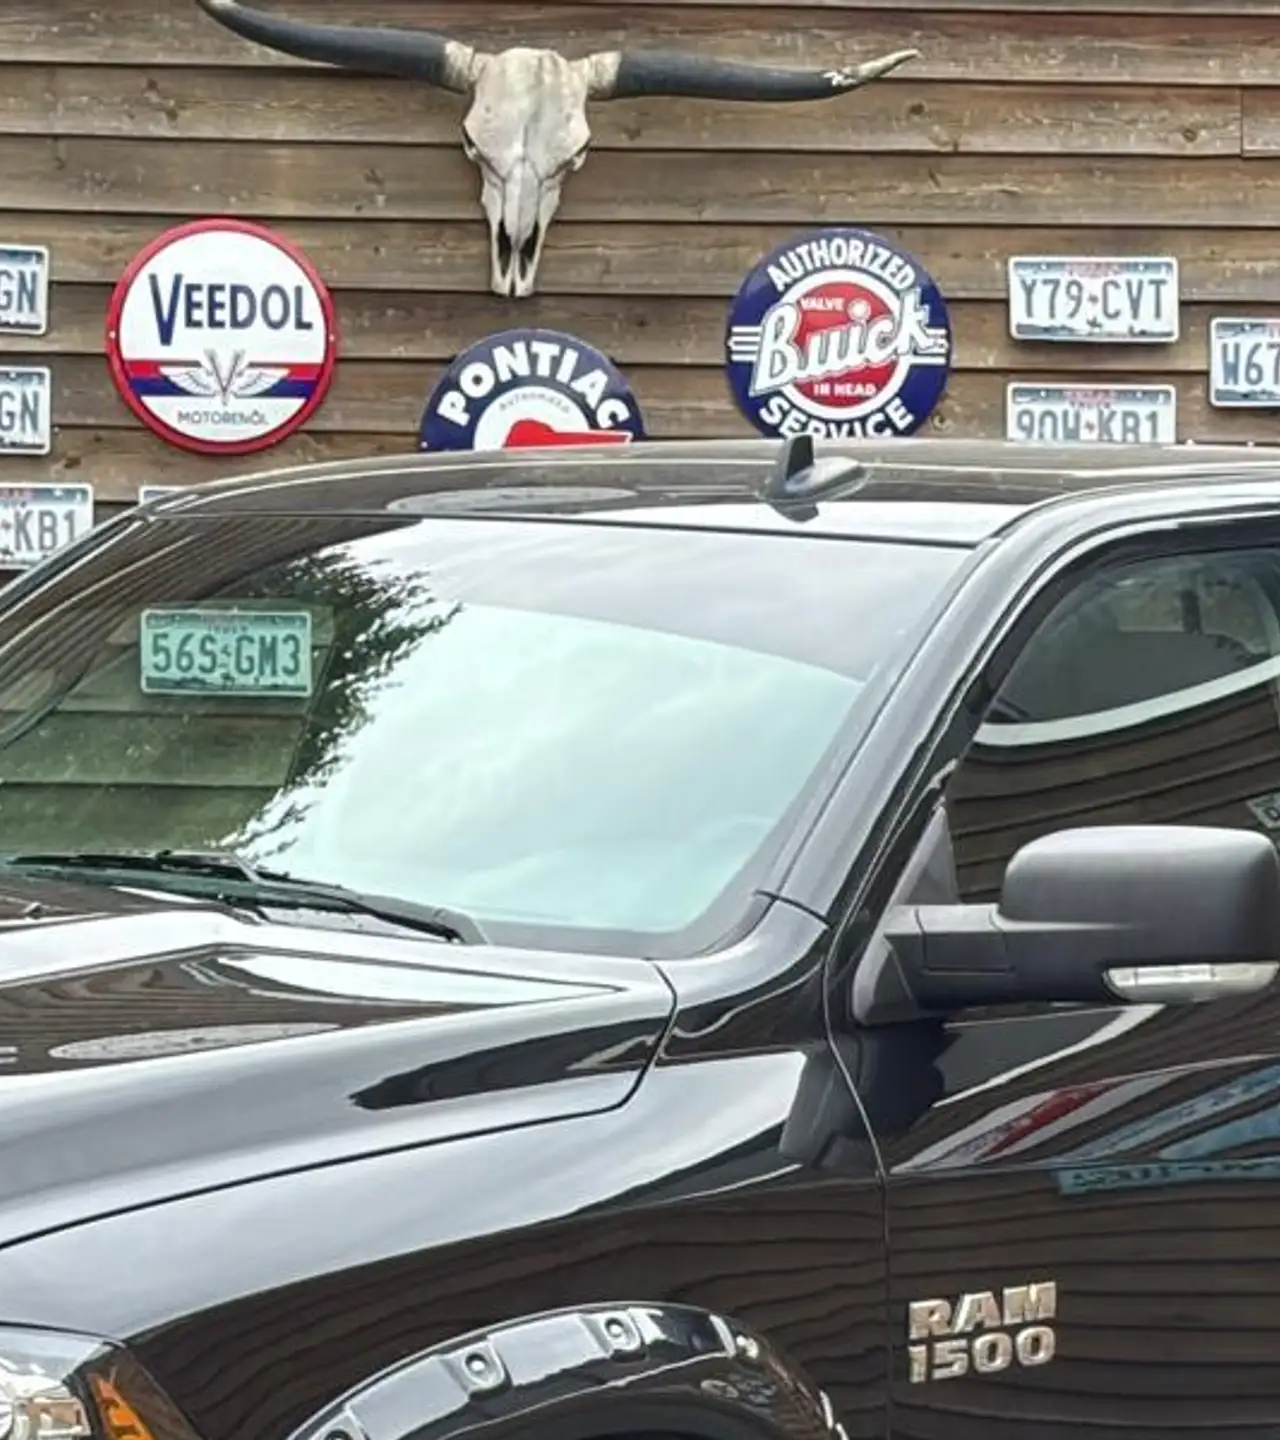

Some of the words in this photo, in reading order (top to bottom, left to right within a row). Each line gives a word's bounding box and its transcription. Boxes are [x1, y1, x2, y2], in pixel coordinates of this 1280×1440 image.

[767, 237, 916, 291] AUTHORIZED
[800, 297, 846, 311] VALVE
[749, 287, 948, 397] Buick
[436, 341, 632, 429] PONTIAC
[813, 384, 830, 396] IN
[834, 384, 877, 397] HEAD
[759, 396, 914, 438] SERVICE
[909, 1281, 1057, 1340] RAM
[908, 1325, 1057, 1384] 1500
